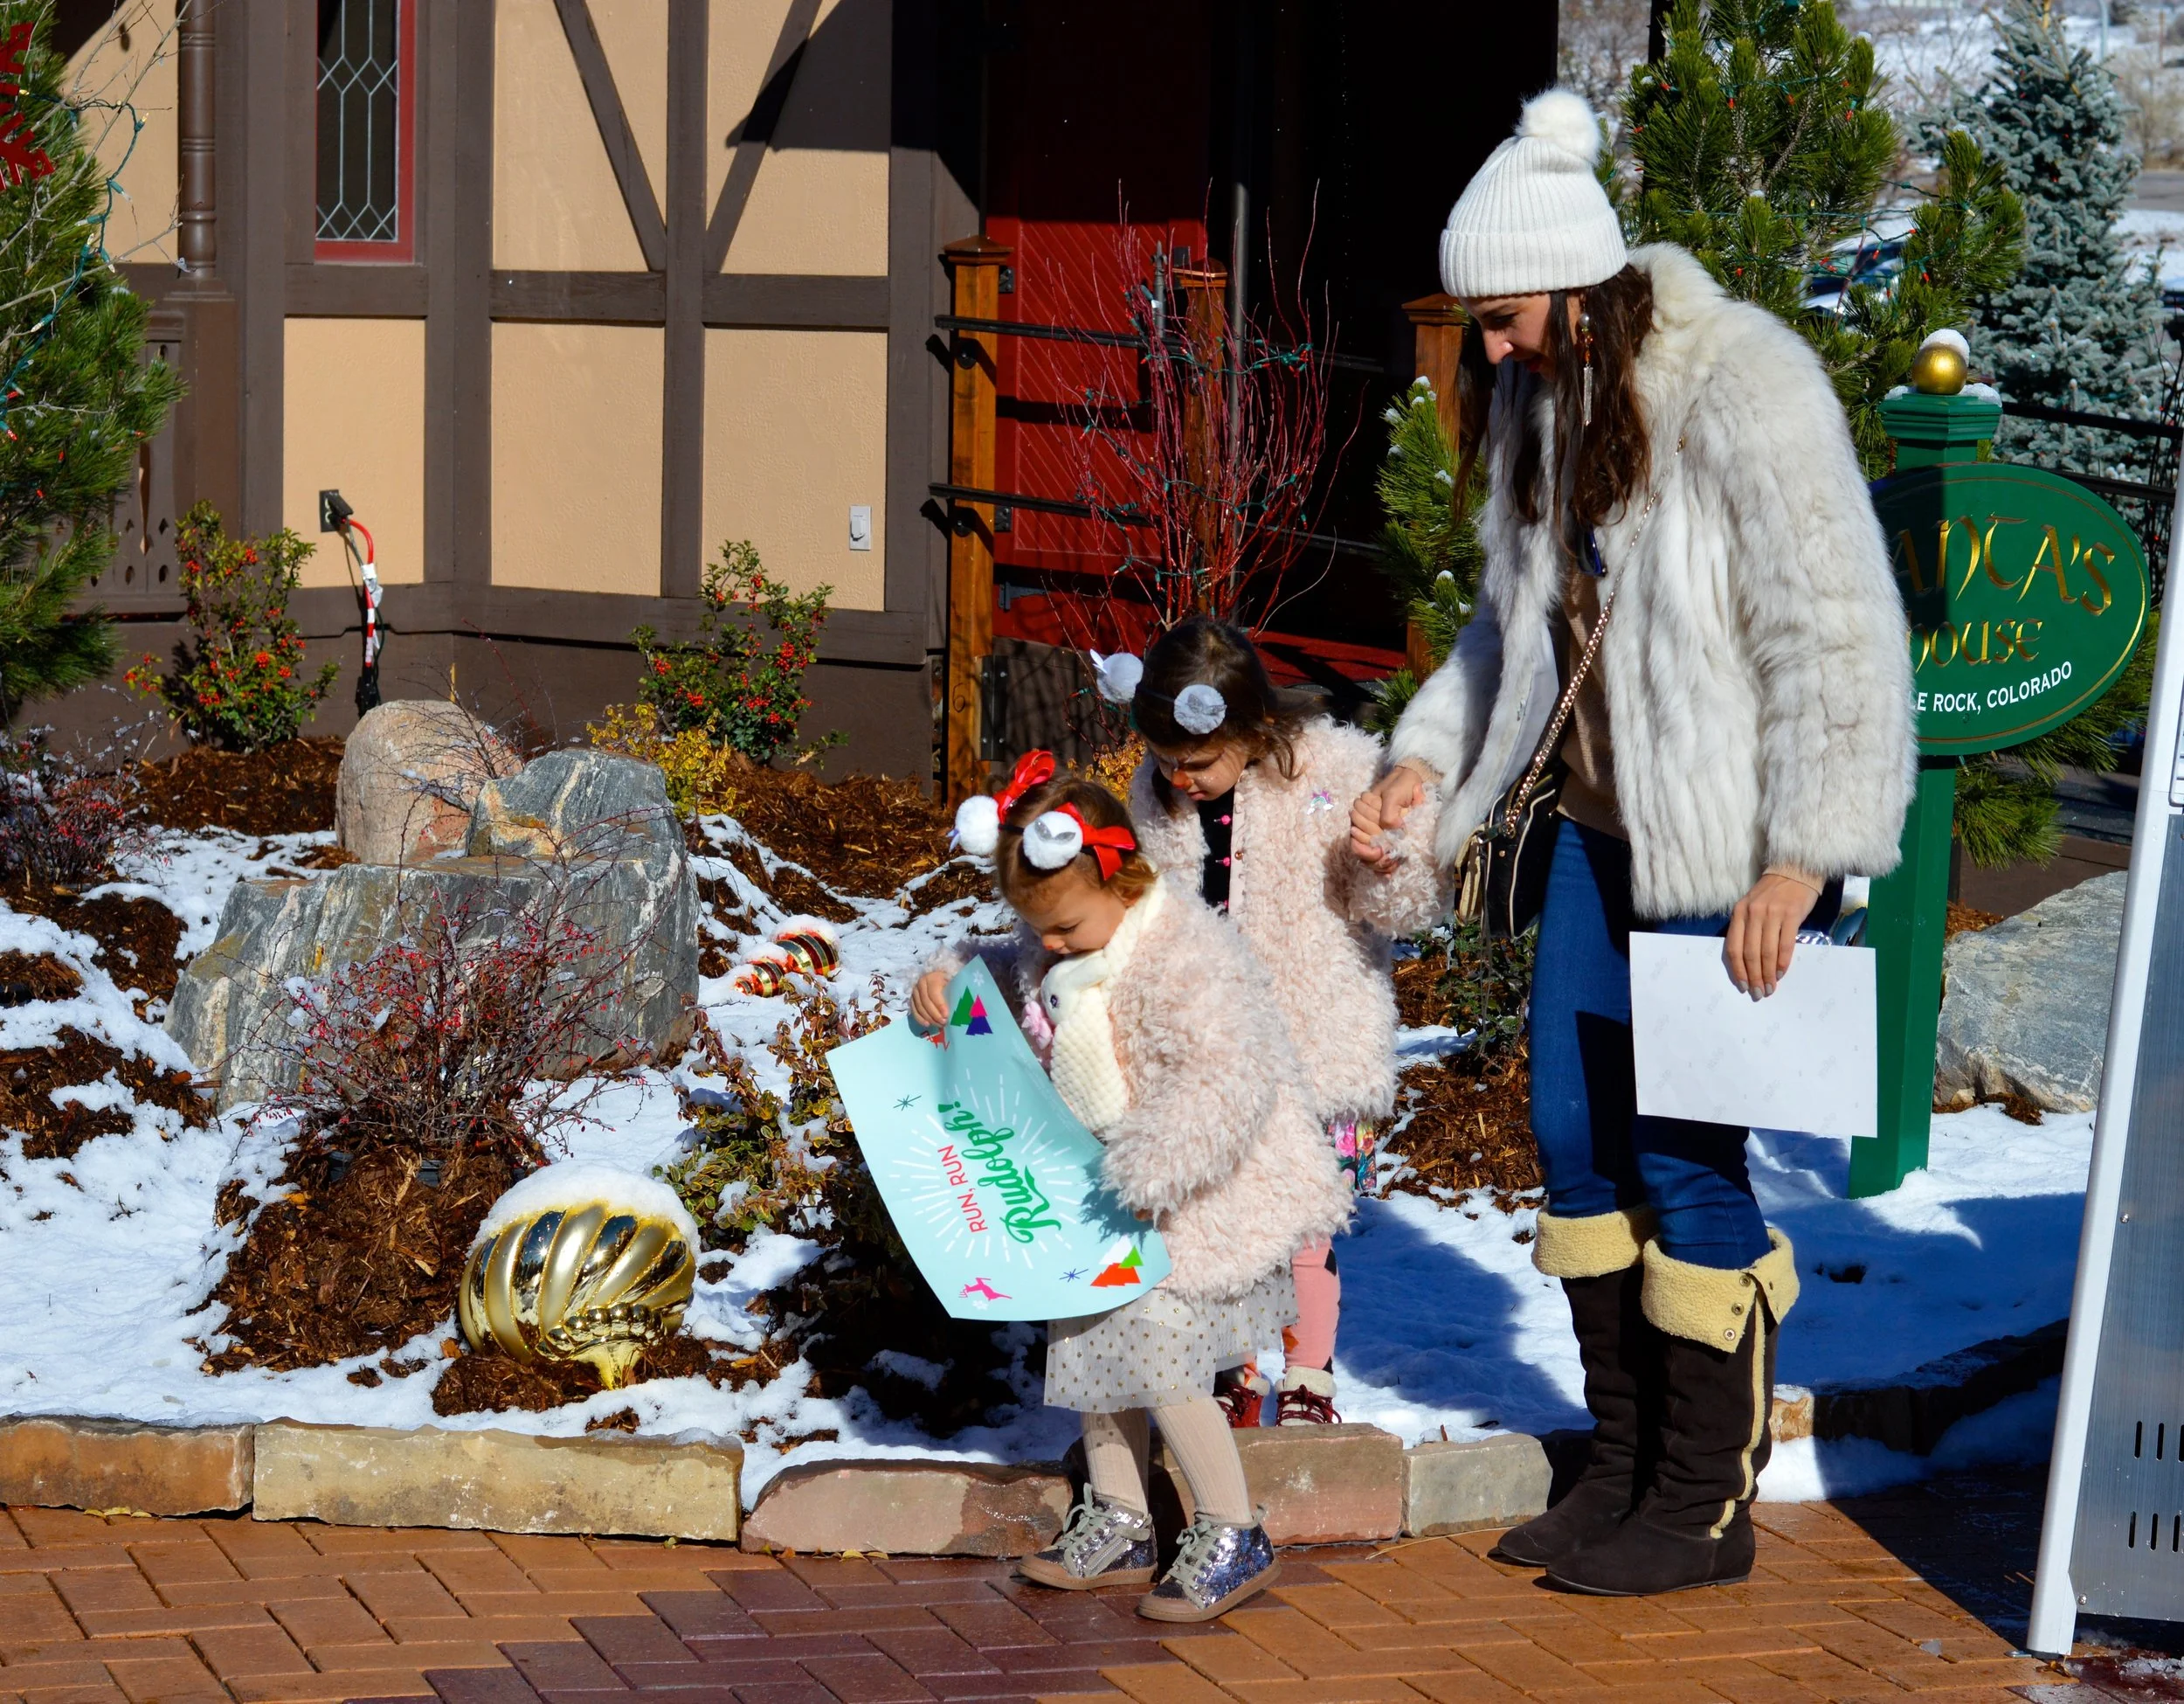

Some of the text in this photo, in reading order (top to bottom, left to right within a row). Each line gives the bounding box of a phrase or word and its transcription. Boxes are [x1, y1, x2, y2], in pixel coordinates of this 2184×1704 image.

[1932, 692, 1981, 715] ROCK,
[1987, 661, 2072, 709] COLORADO
[937, 1100, 1062, 1243] Rudolph!
[937, 1144, 988, 1233] RUN, RUN
